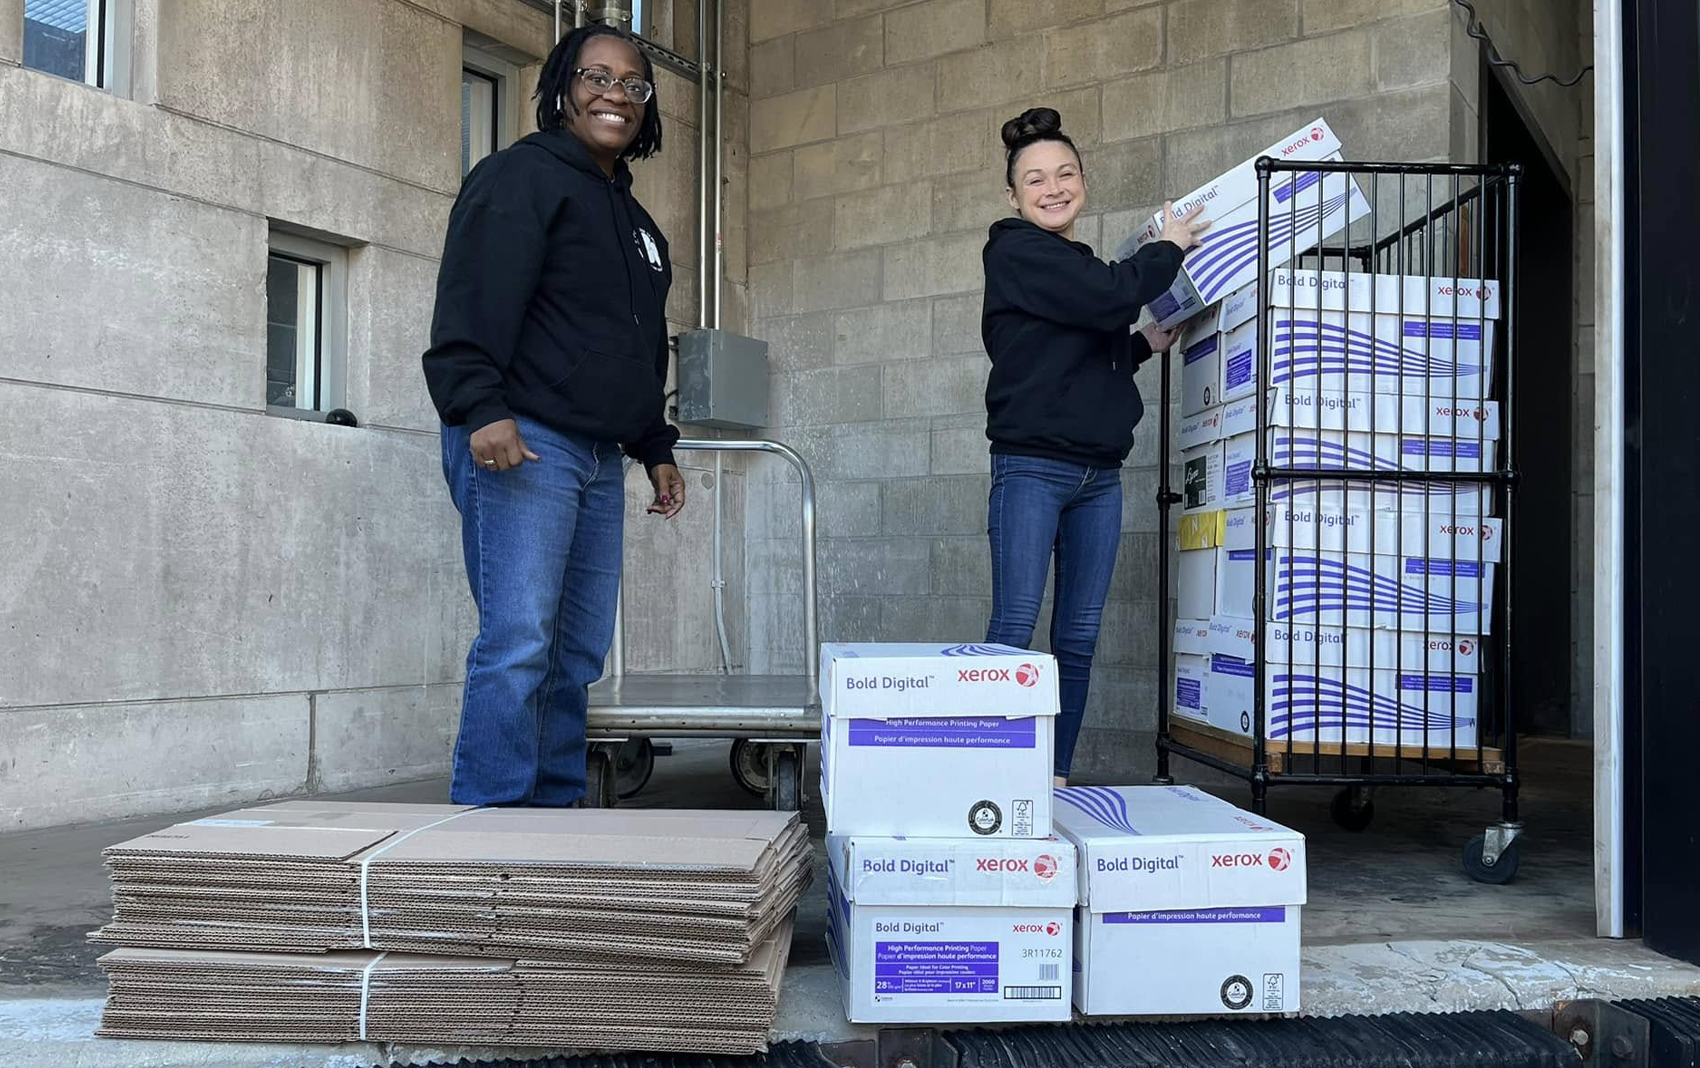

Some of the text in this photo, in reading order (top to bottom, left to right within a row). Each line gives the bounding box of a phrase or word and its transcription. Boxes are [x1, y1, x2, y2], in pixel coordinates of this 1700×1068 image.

[1281, 135, 1310, 157] xerox
[1438, 286, 1472, 296] xeox
[1274, 629, 1300, 641] Bod
[958, 668, 1010, 682] xerox
[846, 676, 877, 690] Bold
[886, 720, 902, 728] High
[950, 720, 977, 728] Printing
[979, 720, 999, 728] Paper
[874, 735, 896, 743] Papier
[898, 735, 942, 744] d'impression
[966, 736, 1010, 744] performance
[863, 859, 896, 872] Bold
[976, 858, 1028, 872] xerox
[1098, 858, 1128, 872] Bold
[1212, 854, 1262, 868] xerox
[1128, 912, 1150, 920] Papier
[1151, 912, 1194, 920] d'impression
[1218, 912, 1261, 920] performance
[876, 922, 900, 932] Bold
[1013, 924, 1043, 932] xerox
[1022, 948, 1062, 958] 3R11762
